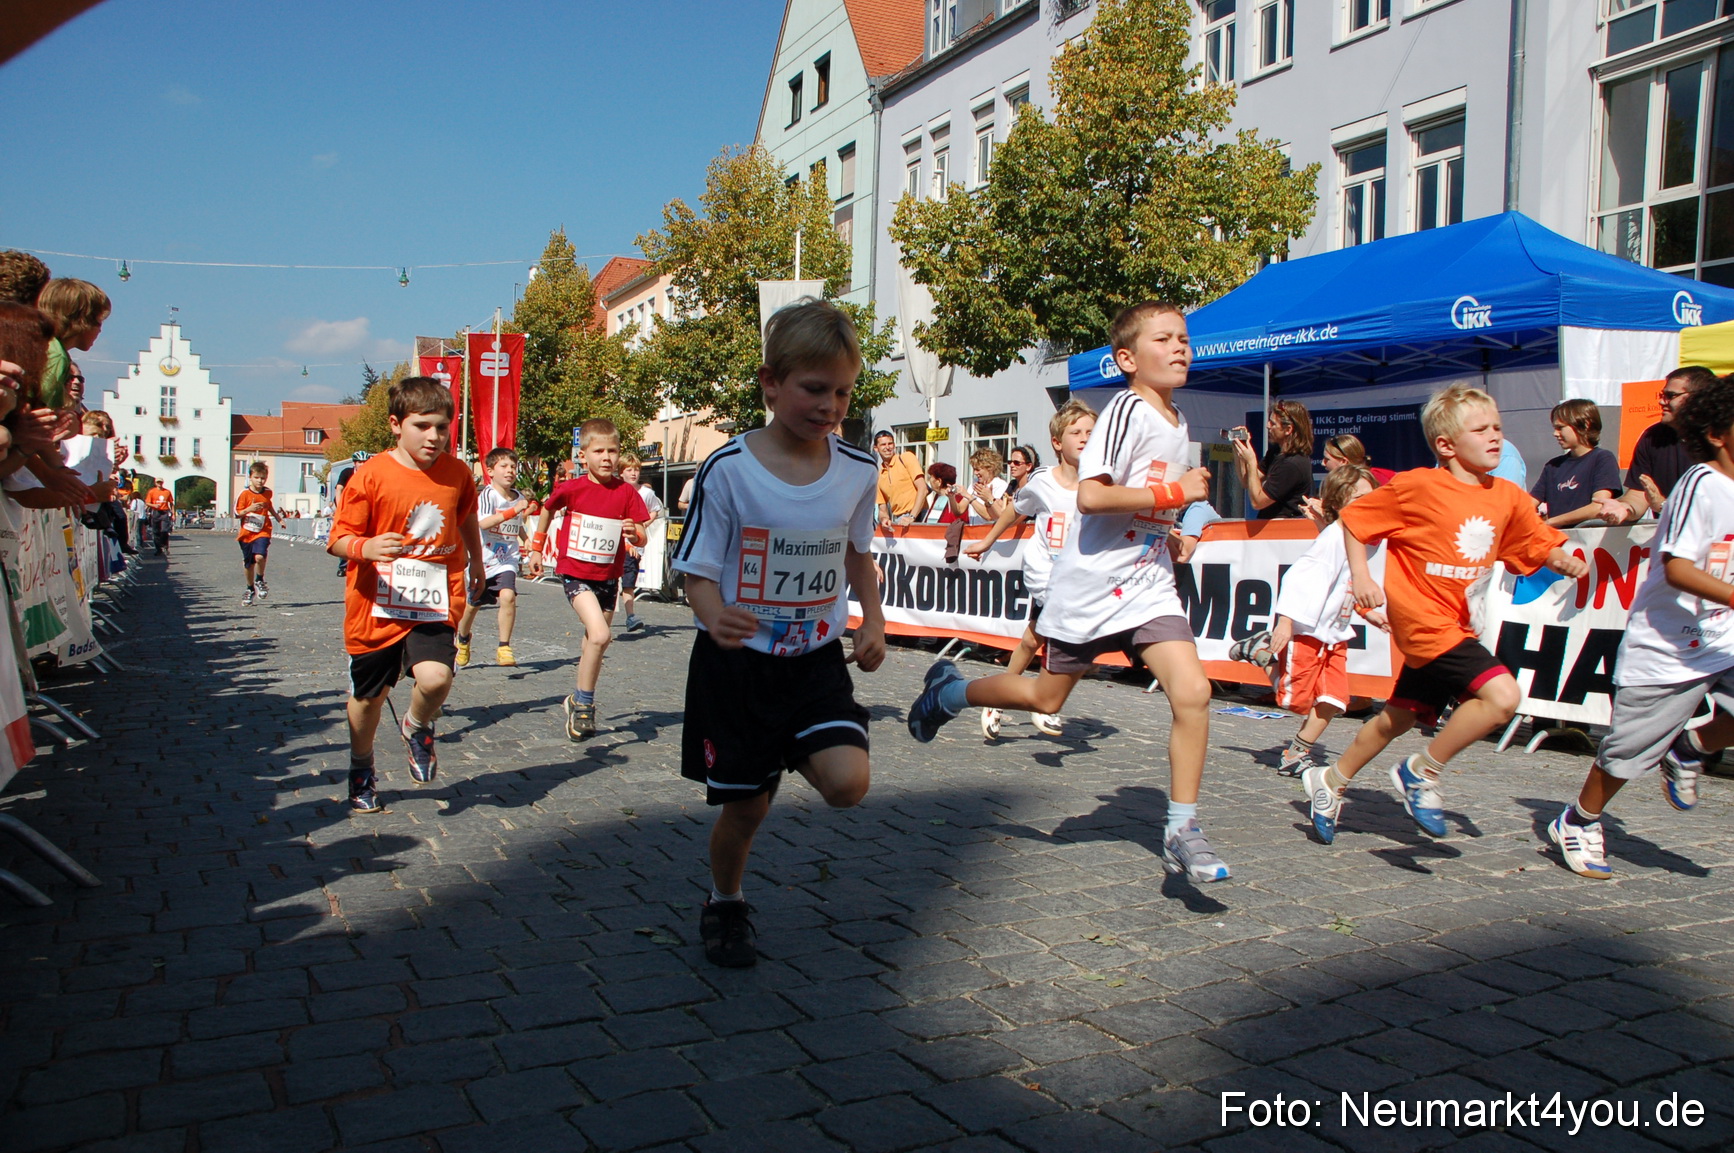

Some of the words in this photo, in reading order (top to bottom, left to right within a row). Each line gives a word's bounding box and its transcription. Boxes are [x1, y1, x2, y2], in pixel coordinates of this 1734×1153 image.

[1196, 323, 1339, 358] www.vereinigte-ikk.de
[1316, 416, 1336, 425] IKK:
[1338, 415, 1354, 424] Der
[1356, 413, 1387, 424] Beitrag
[1338, 425, 1361, 434] auch!
[583, 519, 603, 531] Lukas
[582, 535, 615, 551] 7129
[773, 537, 841, 557] Maximilian
[396, 564, 427, 578] Stefan
[743, 562, 758, 576] K4
[1425, 561, 1477, 580] MERZ
[773, 568, 837, 596] 7140
[397, 586, 442, 605] 7120
